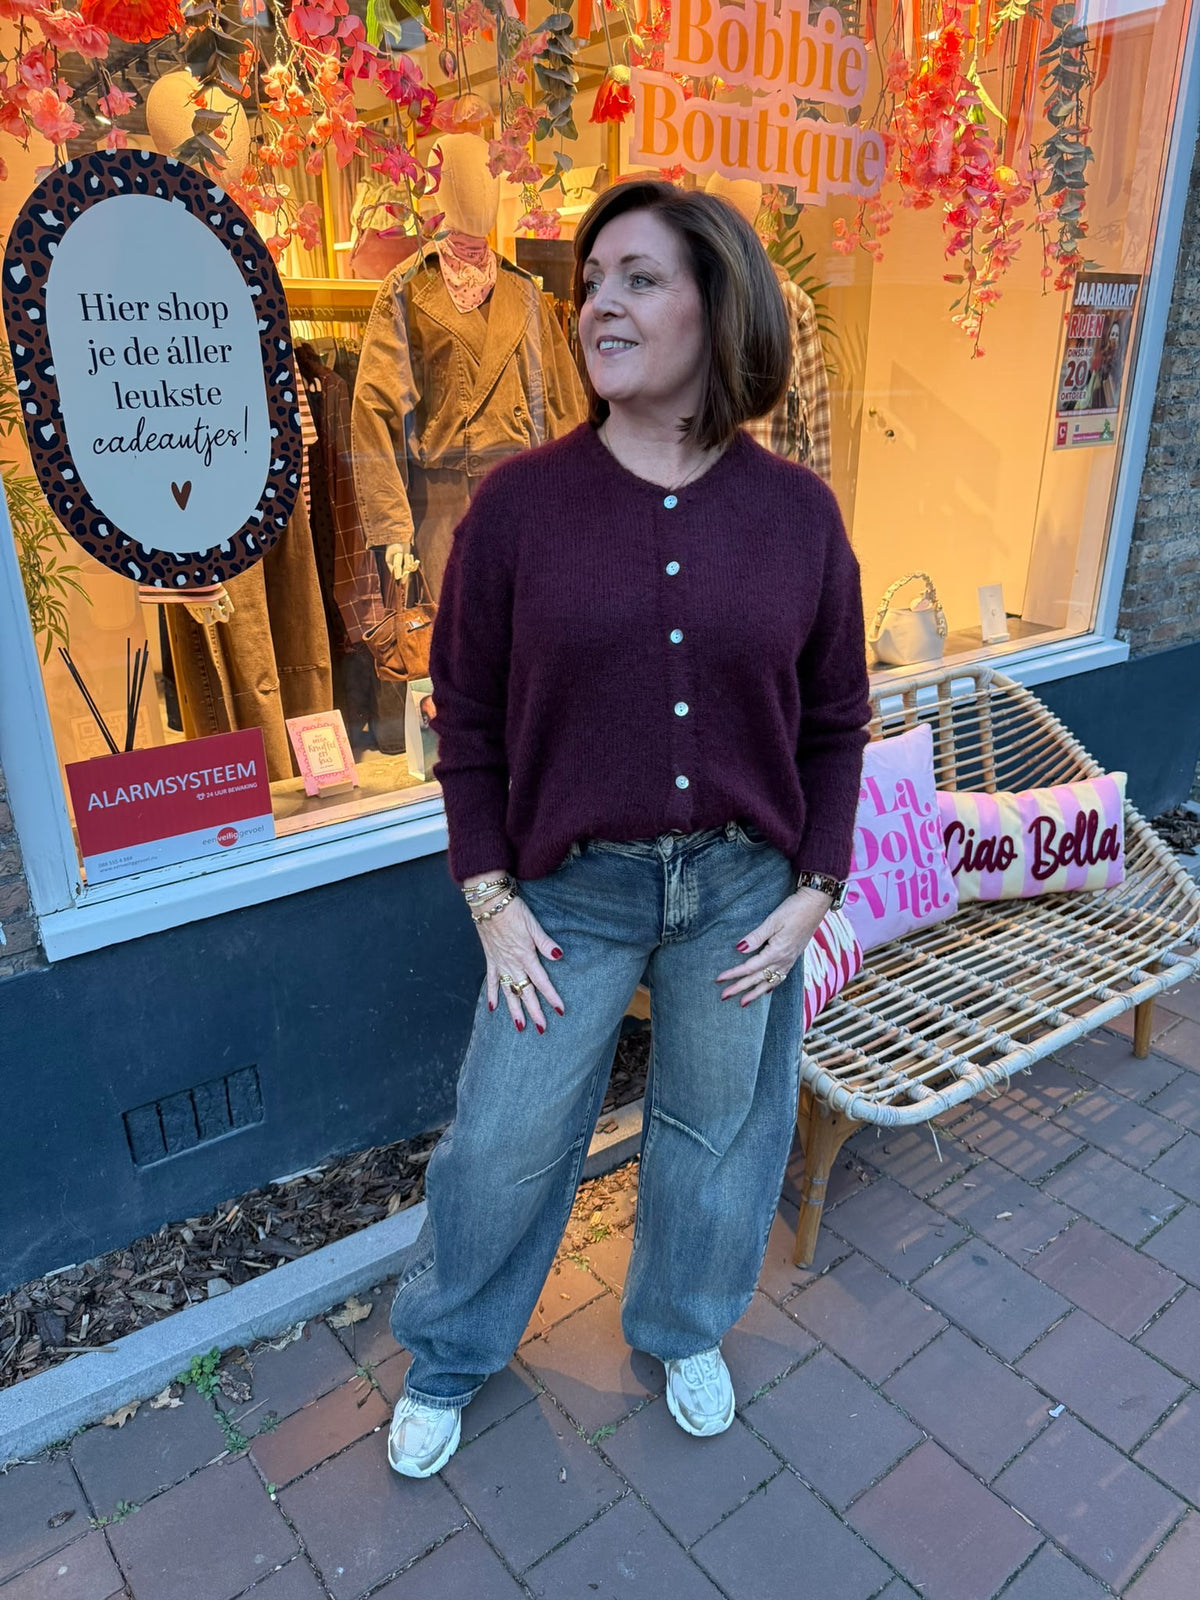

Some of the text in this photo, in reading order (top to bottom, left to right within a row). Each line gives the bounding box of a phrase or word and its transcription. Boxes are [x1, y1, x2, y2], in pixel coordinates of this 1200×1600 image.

[673, 0, 863, 98] Bobbie
[638, 81, 881, 195] Boutique
[77, 292, 229, 328] Hier shop
[1074, 282, 1138, 307] JAARMARKT
[1069, 314, 1105, 338] RIJEN
[88, 336, 233, 375] je de áller
[1067, 348, 1092, 358] DINSDAG
[1064, 360, 1088, 387] 20
[112, 379, 223, 411] leukste
[1060, 391, 1087, 401] OKTOBER
[92, 405, 249, 467] cadeautjes!
[87, 760, 258, 812] ALARMSYSTEEM
[228, 782, 258, 793] BEWAKING
[858, 776, 931, 817] La
[202, 825, 264, 846] een veilig gevoel
[944, 808, 1121, 881] Ciao Bella
[844, 865, 950, 920] Vita
